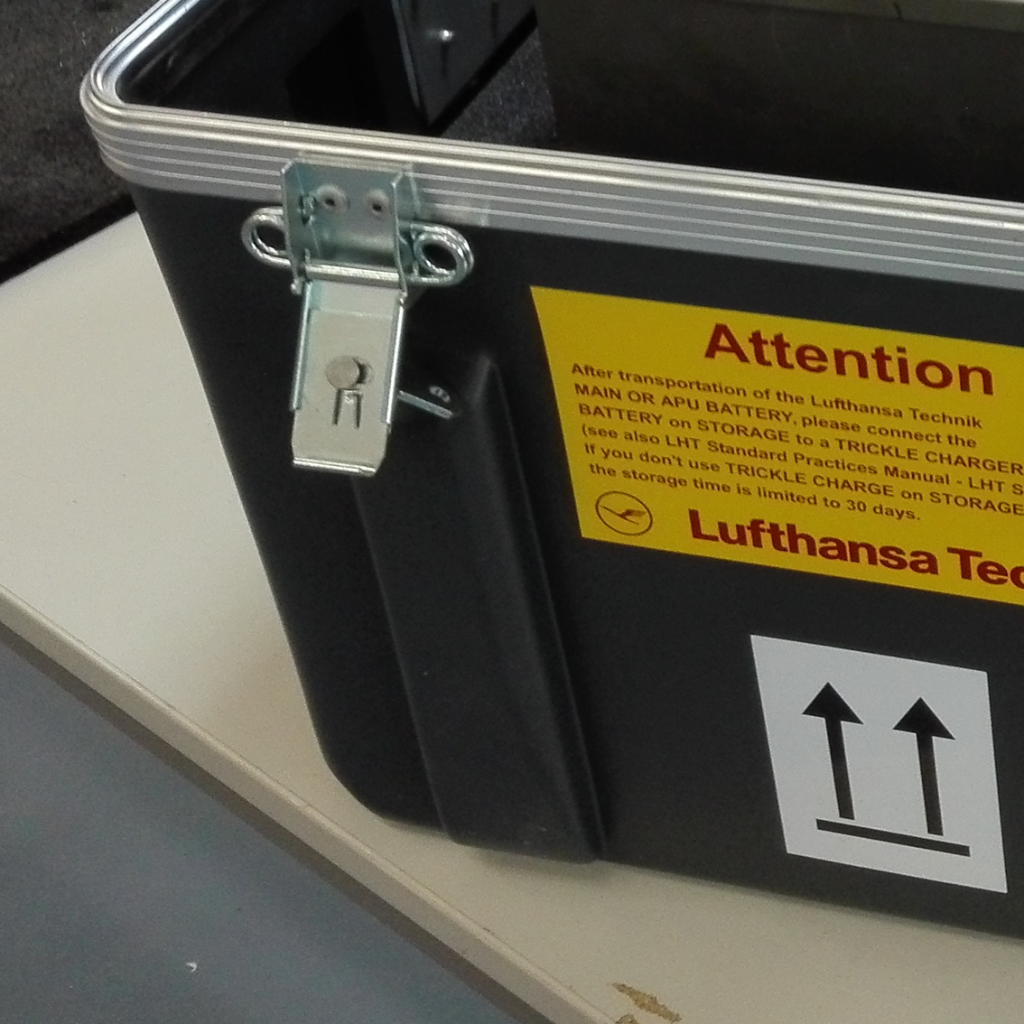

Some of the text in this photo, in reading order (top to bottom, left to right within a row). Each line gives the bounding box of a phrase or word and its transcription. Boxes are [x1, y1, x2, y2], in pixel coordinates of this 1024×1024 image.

[704, 322, 994, 396] Attention
[571, 363, 982, 429] After transportation of the Lufthansa Technik
[574, 383, 622, 401] MAIN
[627, 390, 655, 405] OR
[661, 395, 700, 411] APU
[801, 415, 861, 432] please
[867, 425, 941, 444] connect
[947, 434, 977, 448] the
[578, 403, 662, 425] BATTERY
[669, 418, 692, 430] on
[697, 419, 790, 443] STORAGE
[795, 434, 814, 446] to
[820, 439, 830, 449] a
[835, 438, 919, 461] TRICKLE
[925, 451, 1024, 476] CHARGER
[581, 424, 618, 439] (see
[624, 430, 660, 445] also
[665, 434, 700, 450] LHT
[707, 440, 788, 462] Standard
[793, 452, 878, 475] Practices
[883, 465, 950, 485] Manual
[968, 476, 1005, 493] LHT
[584, 442, 597, 456] If
[600, 447, 633, 460] you
[639, 451, 683, 467] don't
[688, 460, 720, 472] use
[725, 462, 807, 485] TRICKLE
[812, 475, 894, 497] CHARGE
[901, 490, 923, 501] on
[589, 463, 920, 521] the storage time is limited to 30 days.
[687, 508, 939, 576] Lufthansa
